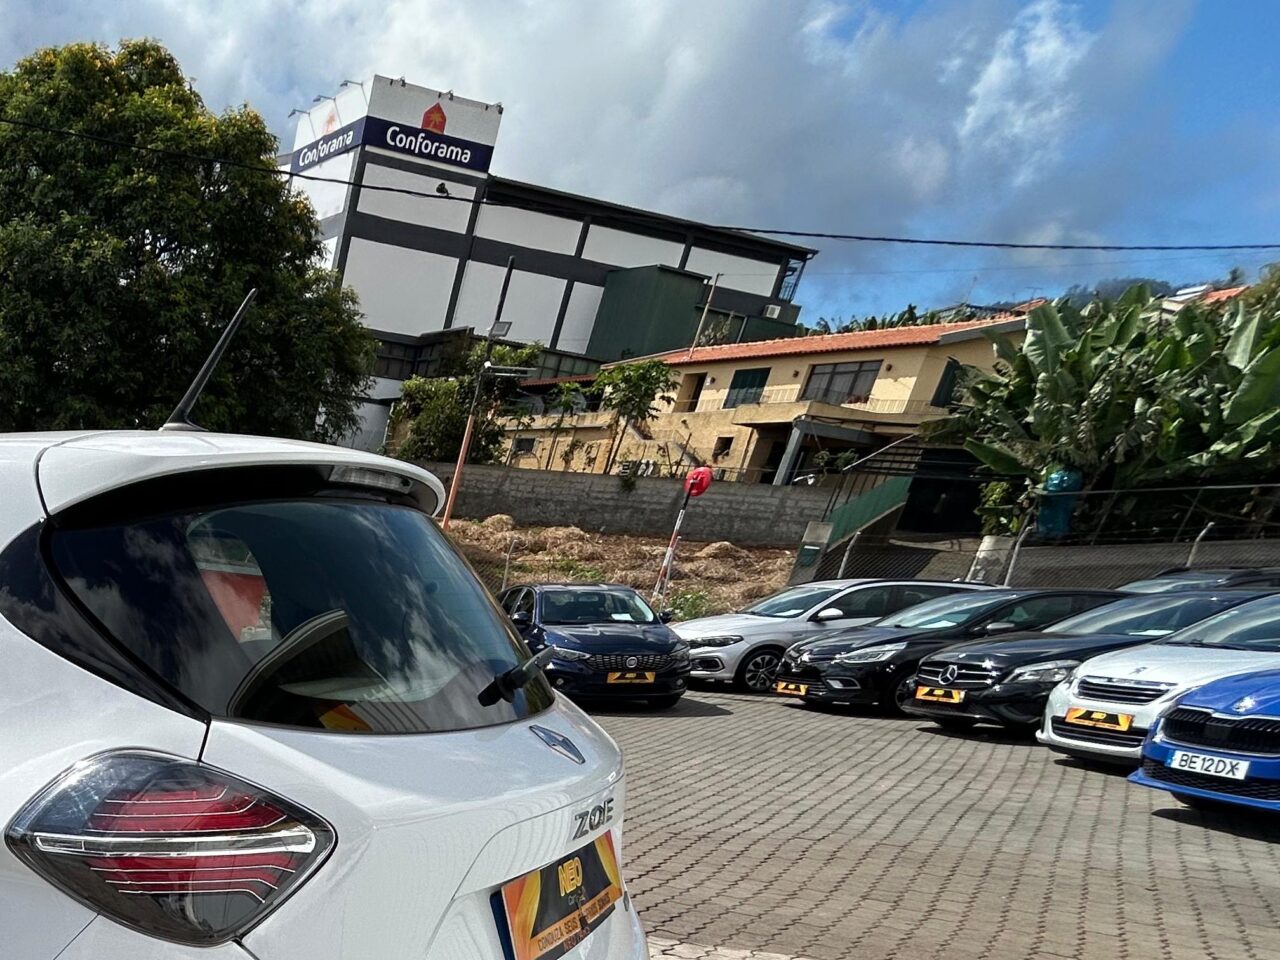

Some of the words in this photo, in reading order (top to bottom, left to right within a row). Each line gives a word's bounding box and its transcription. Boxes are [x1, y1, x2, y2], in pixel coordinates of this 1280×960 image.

[299, 131, 354, 167] Conforama
[386, 126, 471, 163] Conforama
[1179, 754, 1240, 776] BE12DX
[572, 797, 614, 840] ZOE
[558, 857, 583, 897] NEO
